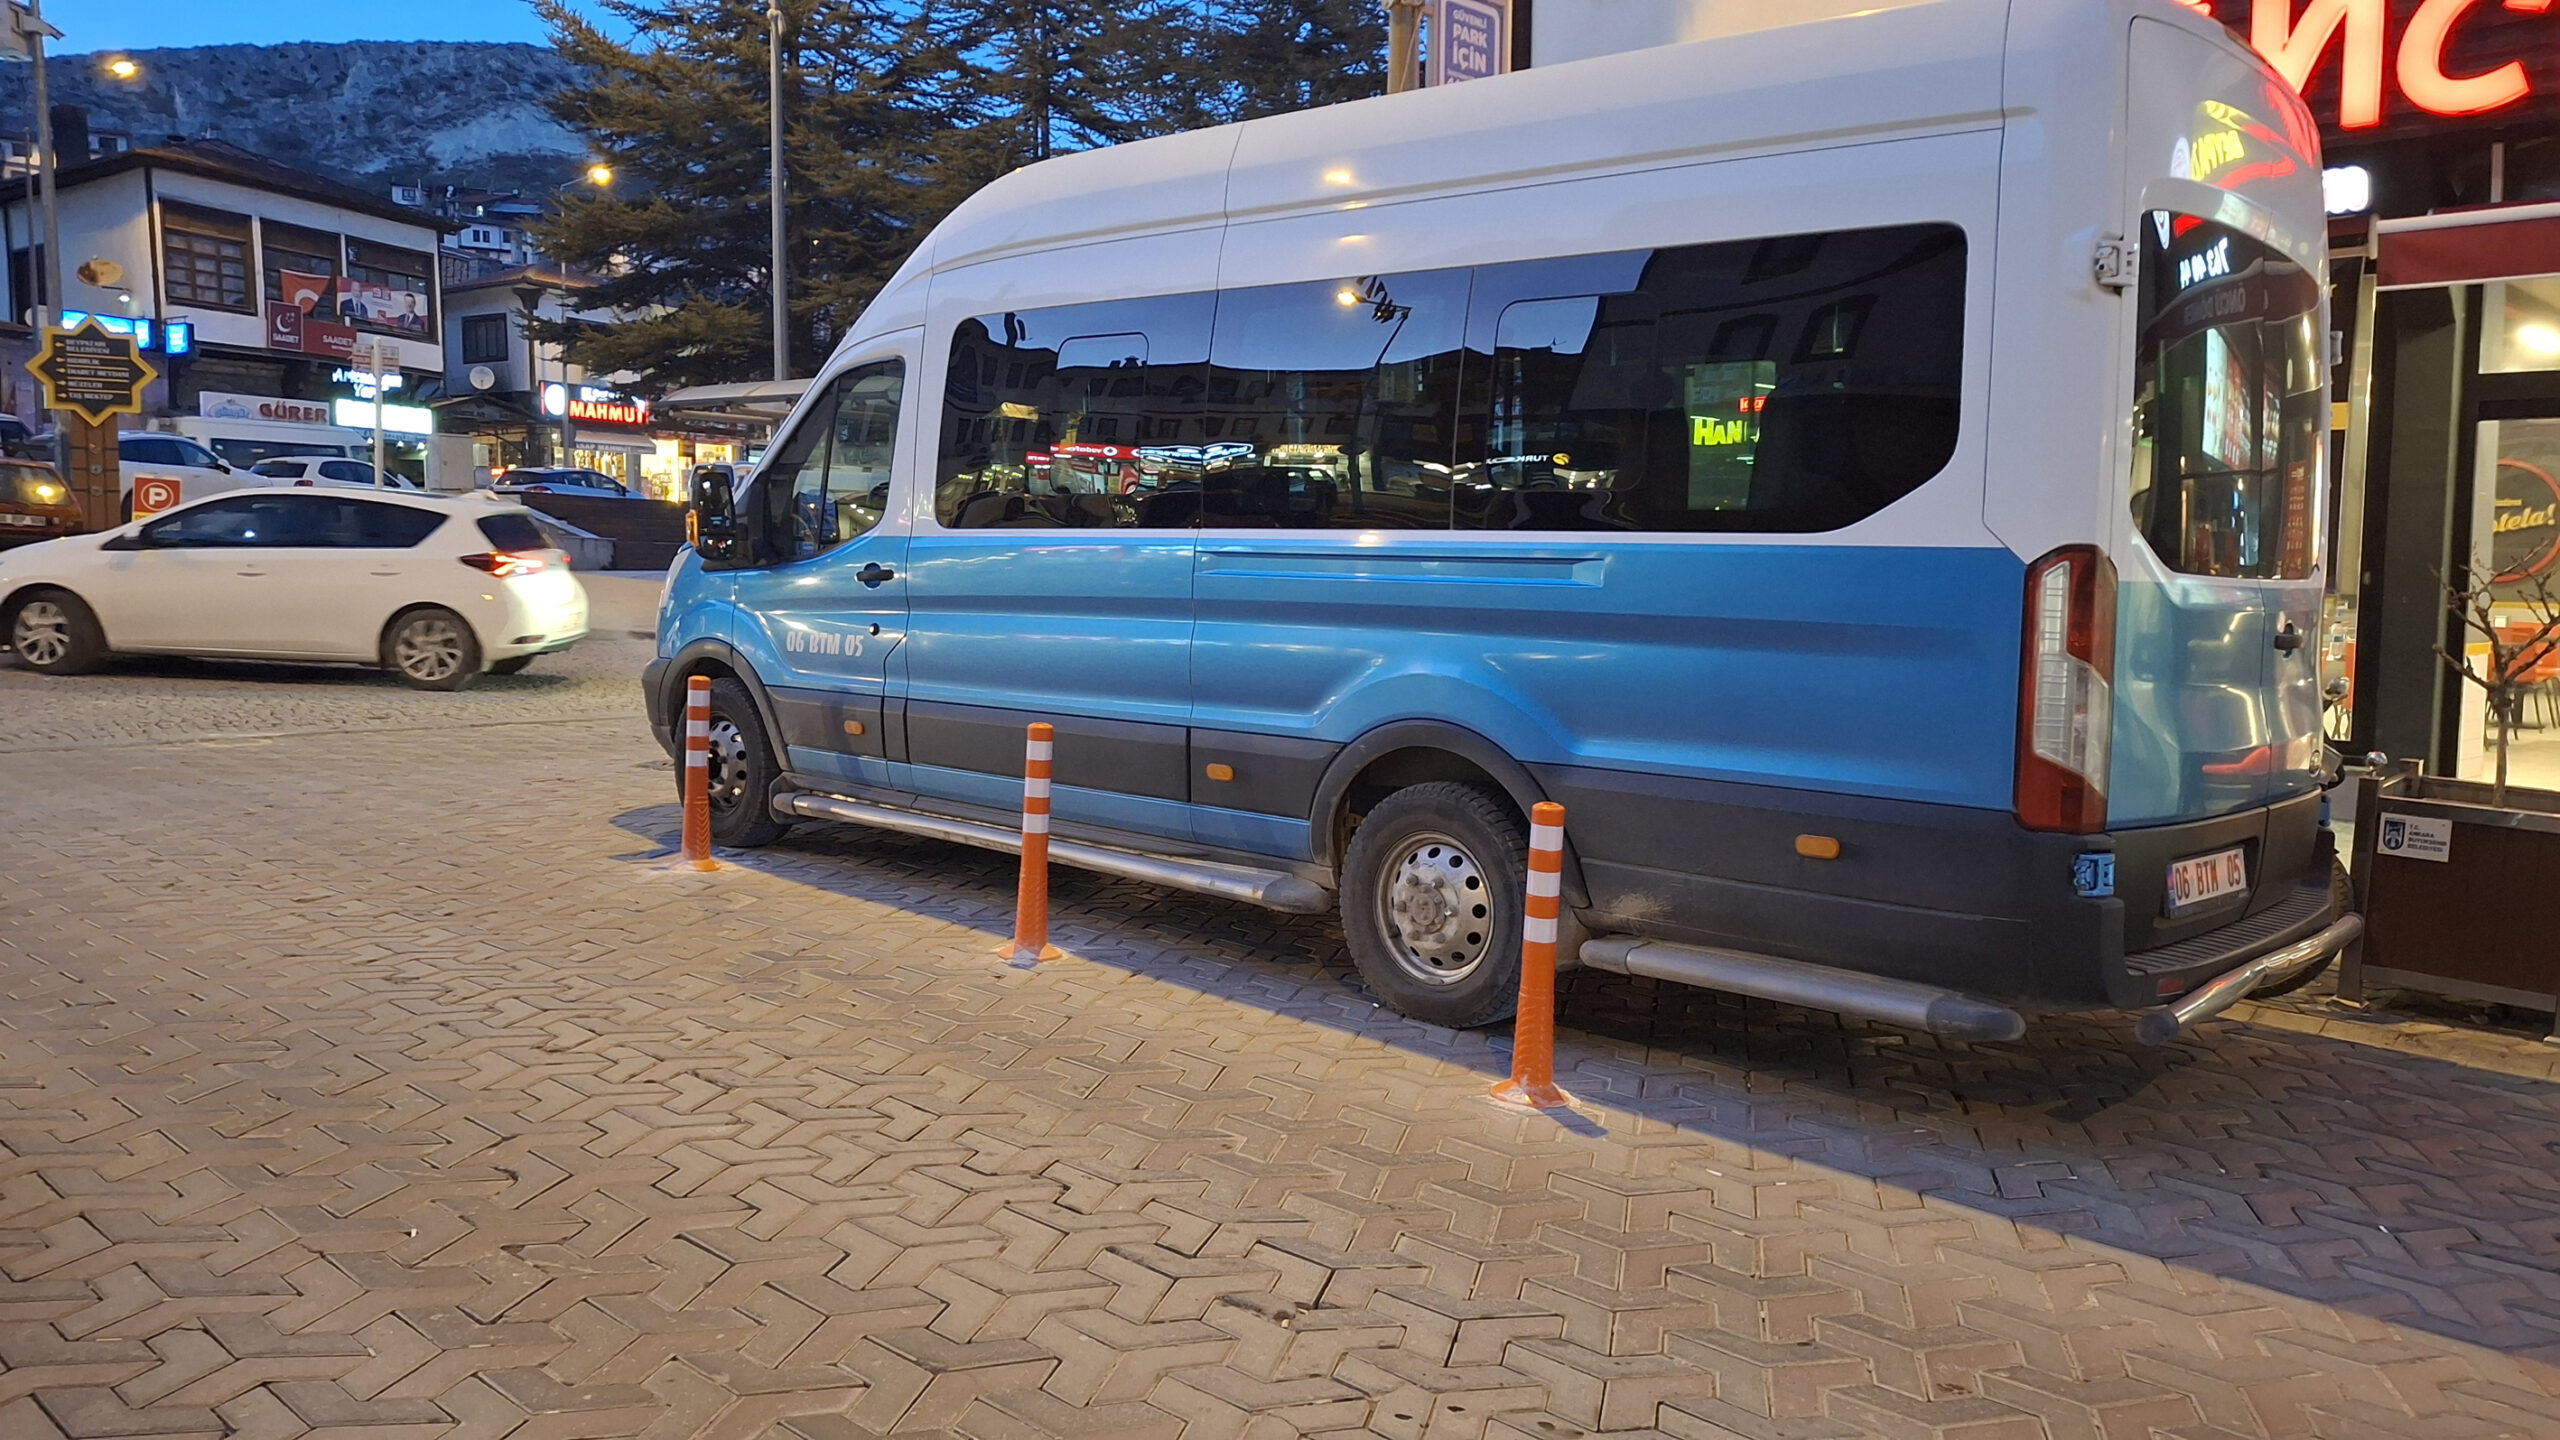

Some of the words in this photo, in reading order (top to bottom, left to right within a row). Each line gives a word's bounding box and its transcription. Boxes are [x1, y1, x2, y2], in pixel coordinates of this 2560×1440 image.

[1453, 9, 1487, 29] GÜVENLİ
[1453, 23, 1488, 48] PARK
[1453, 41, 1487, 73] İÇİN
[272, 333, 299, 344] SAADET
[323, 334, 353, 346] SAADET
[259, 401, 327, 423] GÜRER
[569, 400, 643, 424] MAHMUT
[1693, 418, 1742, 445] HAN
[148, 487, 168, 506] P
[786, 631, 804, 652] 06
[809, 632, 840, 655] BTM
[845, 635, 864, 657] 05
[2175, 866, 2191, 901] 06
[2196, 858, 2219, 896] BTM
[2226, 854, 2241, 887] 05
